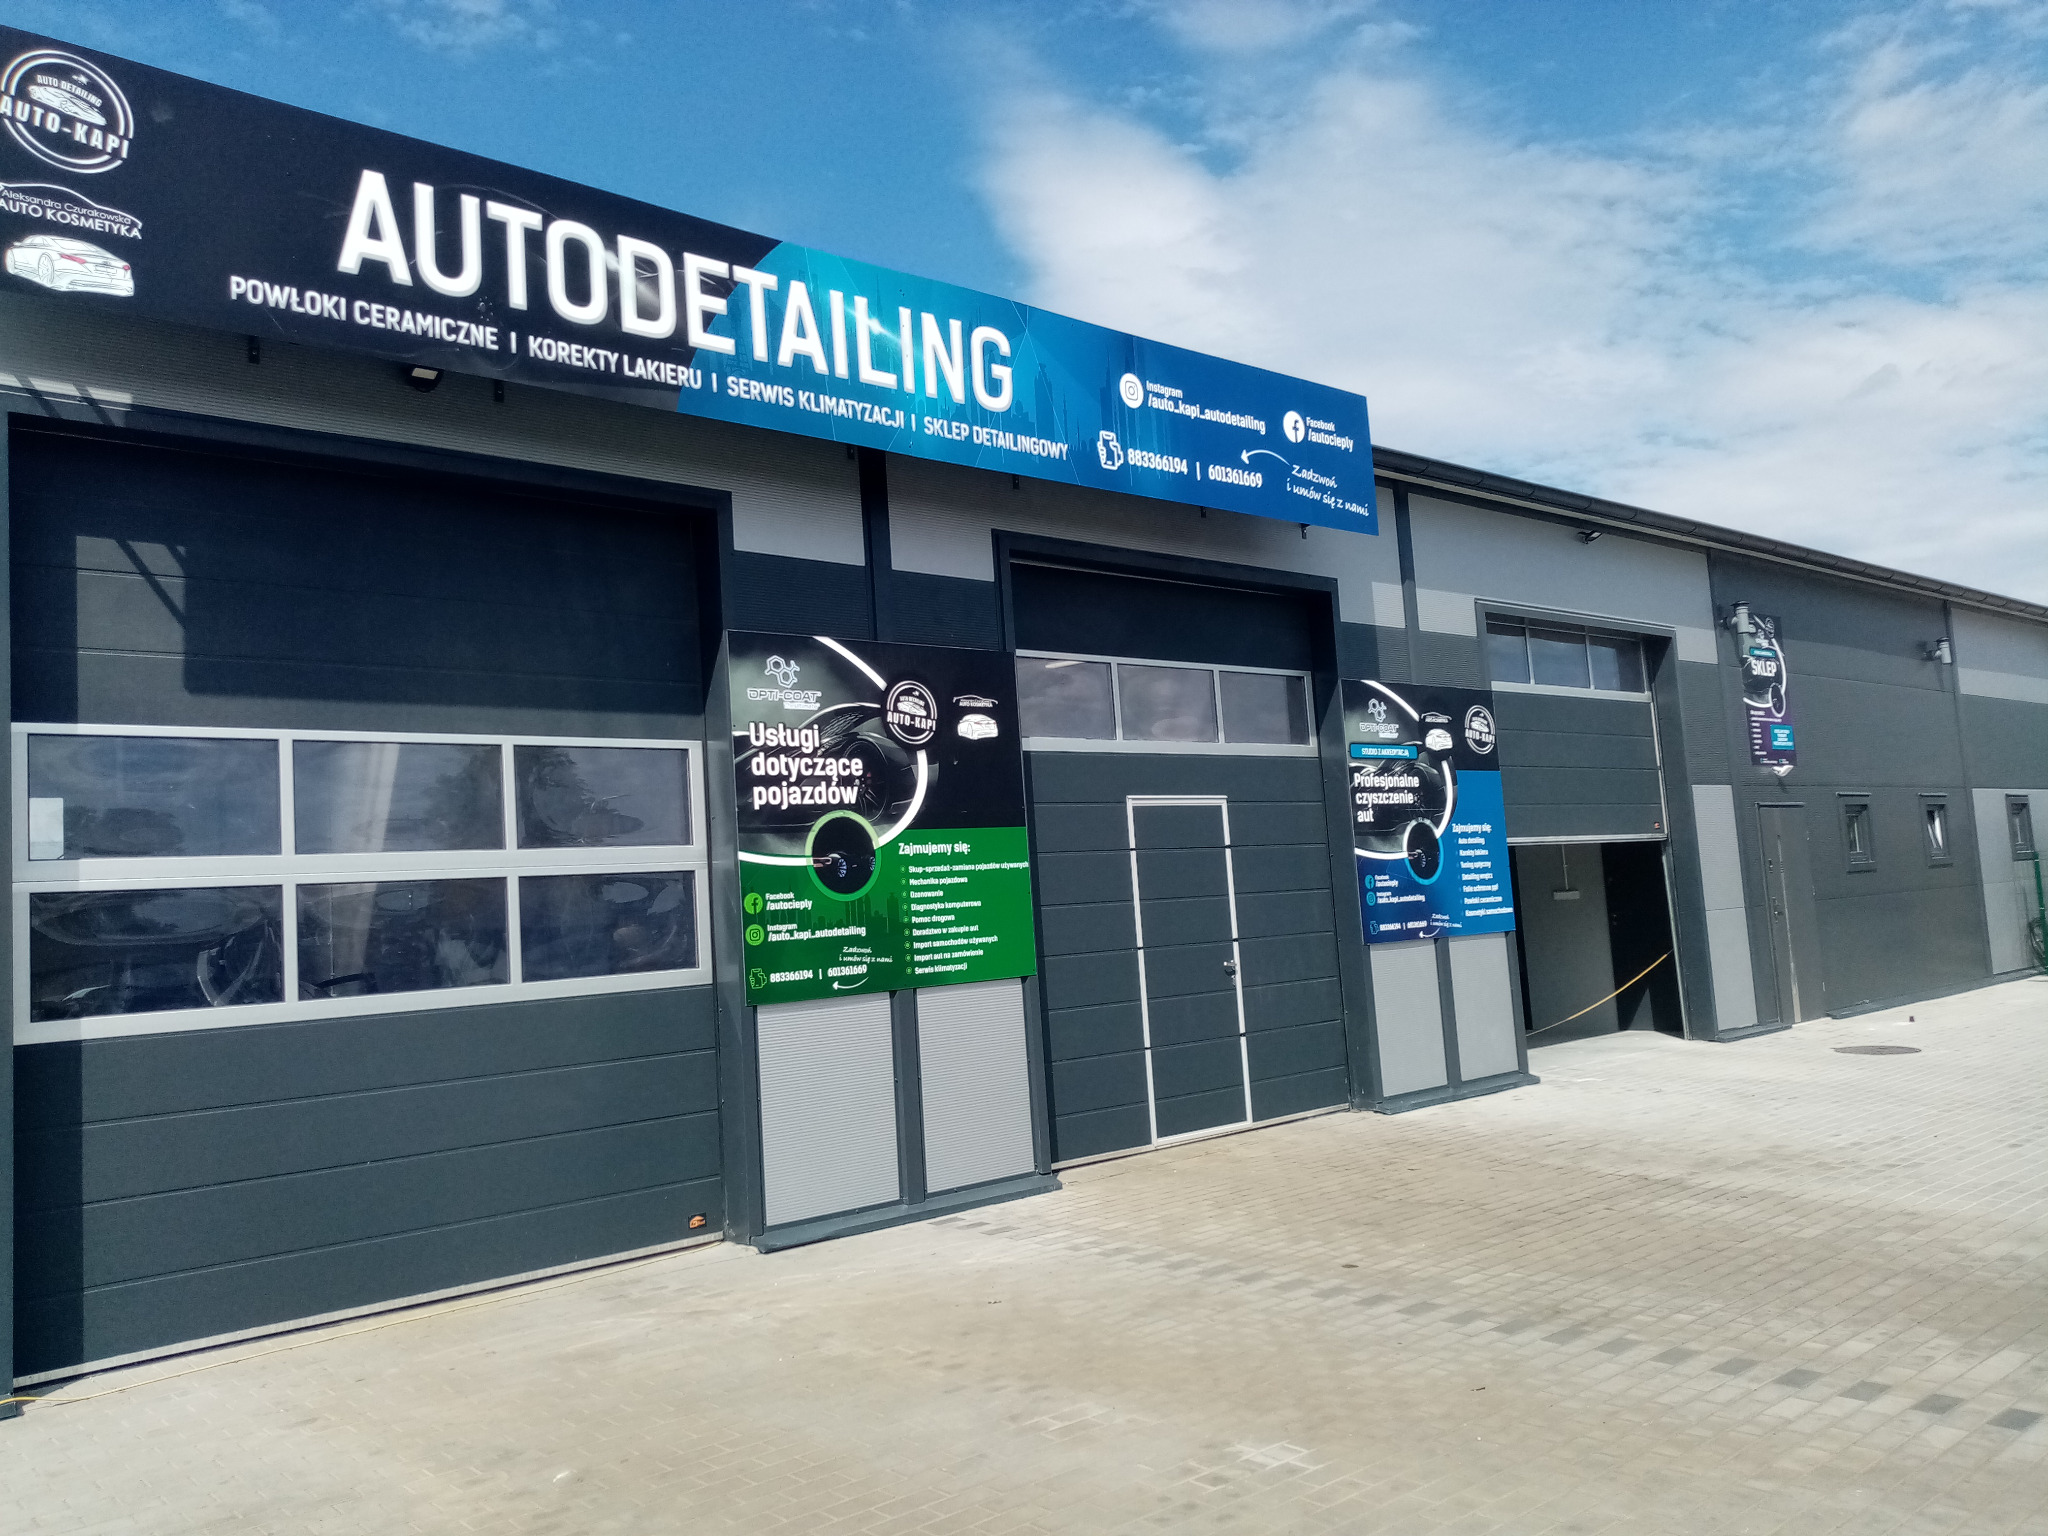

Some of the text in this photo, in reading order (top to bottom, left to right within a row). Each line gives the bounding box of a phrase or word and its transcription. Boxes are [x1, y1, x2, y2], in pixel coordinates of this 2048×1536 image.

[38, 74, 103, 107] AUTO DETAILING
[0, 95, 130, 159] AUTO-KAPI
[1, 189, 131, 225] Aleksandra Czurakowska
[46, 208, 142, 240] KOSMETYKA
[337, 169, 1014, 413] AUTODETAILING
[229, 275, 347, 322] POWŁOKI
[353, 299, 499, 351] CERAMICZNE
[528, 335, 619, 376] KOREKTY
[623, 354, 702, 390] LAKIERU
[727, 375, 795, 408] SERWIS
[799, 390, 905, 430] KLIMATYZACJI
[924, 416, 970, 442] SKLEP
[973, 427, 1068, 461] DETAILINGOWY
[1146, 381, 1183, 399] Instagram
[1148, 394, 1266, 435] /auto_kapi_autodetailing
[1306, 417, 1336, 432] Facebook
[1308, 429, 1354, 453] /autocieply
[1127, 448, 1188, 475] 883366194
[1208, 464, 1263, 489] 601361669
[1292, 464, 1338, 489] Zadzwoń
[1286, 478, 1370, 517] i umów się z nami
[1752, 659, 1777, 677] SKLEP
[747, 688, 822, 702] OPTI-COAT
[887, 710, 936, 731] AUTO-KAPI
[749, 722, 820, 752] Usługi
[751, 753, 864, 783] dotyczące
[1354, 772, 1420, 790] Profesjonalne
[752, 781, 859, 810] pojazdów
[1356, 790, 1414, 808] czyszczenie
[1357, 808, 1375, 823] aut
[898, 841, 971, 856] Zajmujemy się:
[765, 892, 795, 900] Facebook
[766, 899, 813, 911] /autocieply
[767, 924, 798, 932] Instagram
[768, 926, 866, 942] /auto_kapi_autodetailing
[914, 941, 932, 950] Import
[914, 954, 933, 962] Import
[770, 970, 814, 983] 883366194
[827, 964, 868, 977] 601361669
[915, 965, 934, 975] Serwis
